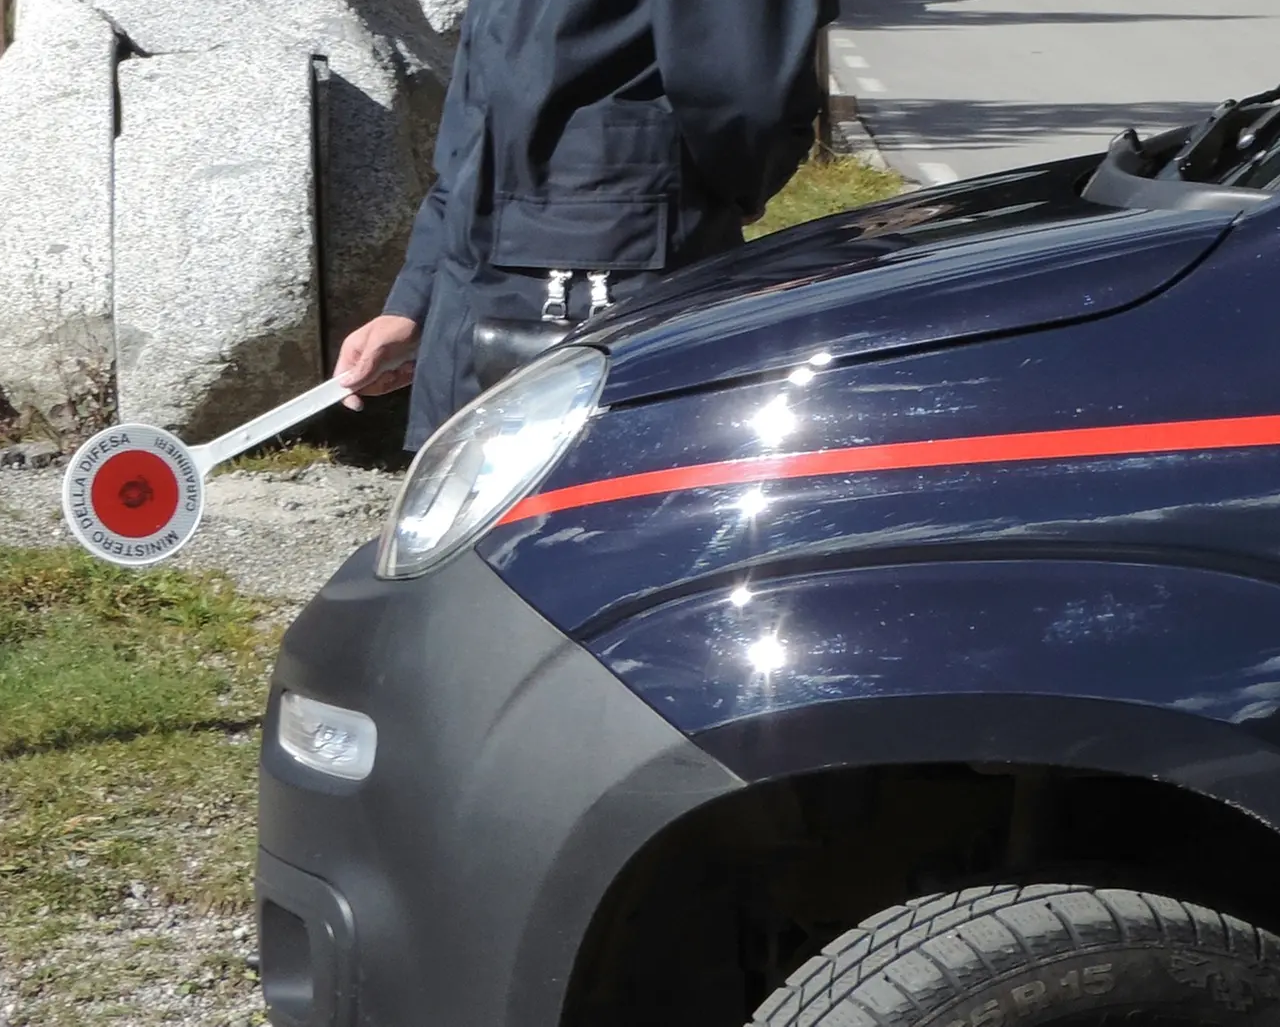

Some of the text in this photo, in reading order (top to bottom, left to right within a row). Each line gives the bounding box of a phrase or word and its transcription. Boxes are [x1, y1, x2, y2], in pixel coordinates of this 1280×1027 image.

[72, 433, 179, 557] MINISTERO DELLA DIFESA
[1060, 961, 1115, 1002] 15
